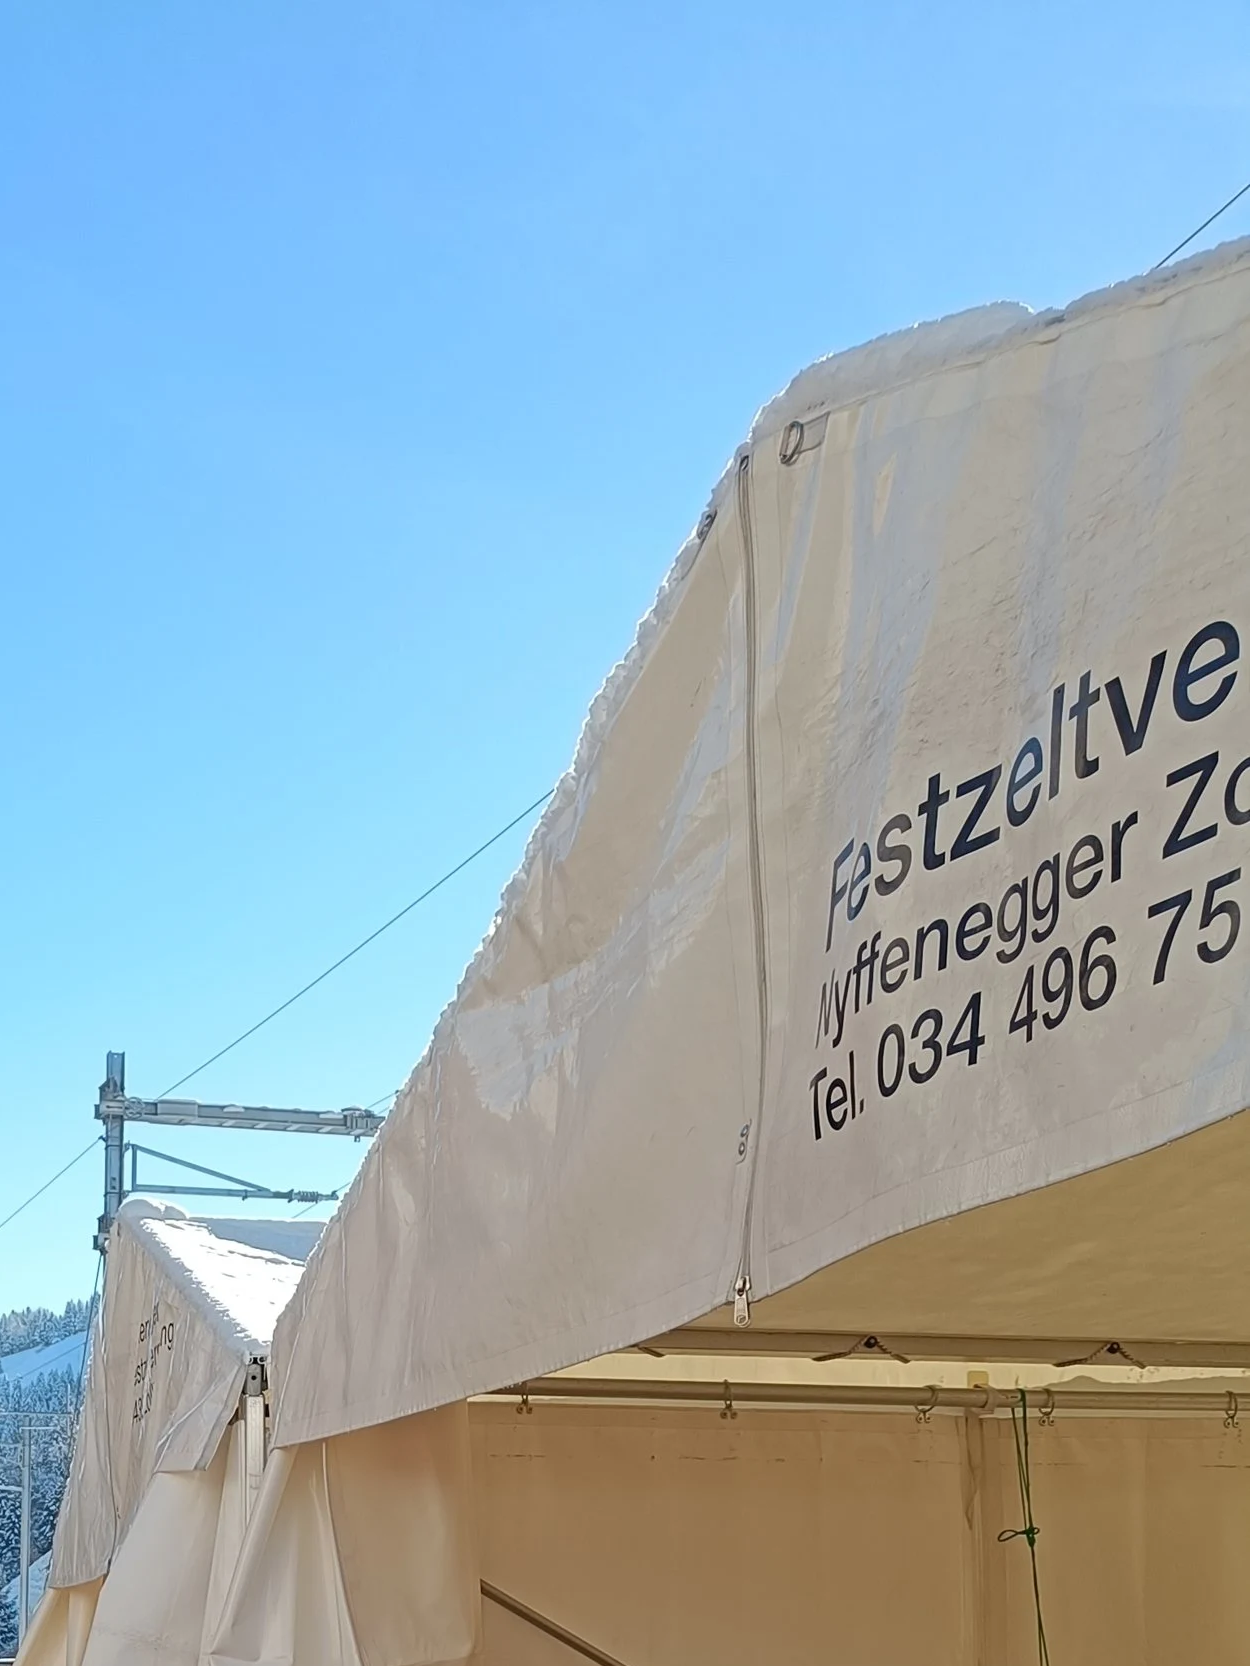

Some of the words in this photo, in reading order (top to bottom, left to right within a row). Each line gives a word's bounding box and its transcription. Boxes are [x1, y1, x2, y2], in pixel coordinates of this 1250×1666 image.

[809, 1051, 865, 1141] Tel.
[877, 991, 985, 1098] 034
[1008, 925, 1117, 1043] 496
[1148, 868, 1242, 985] 75
